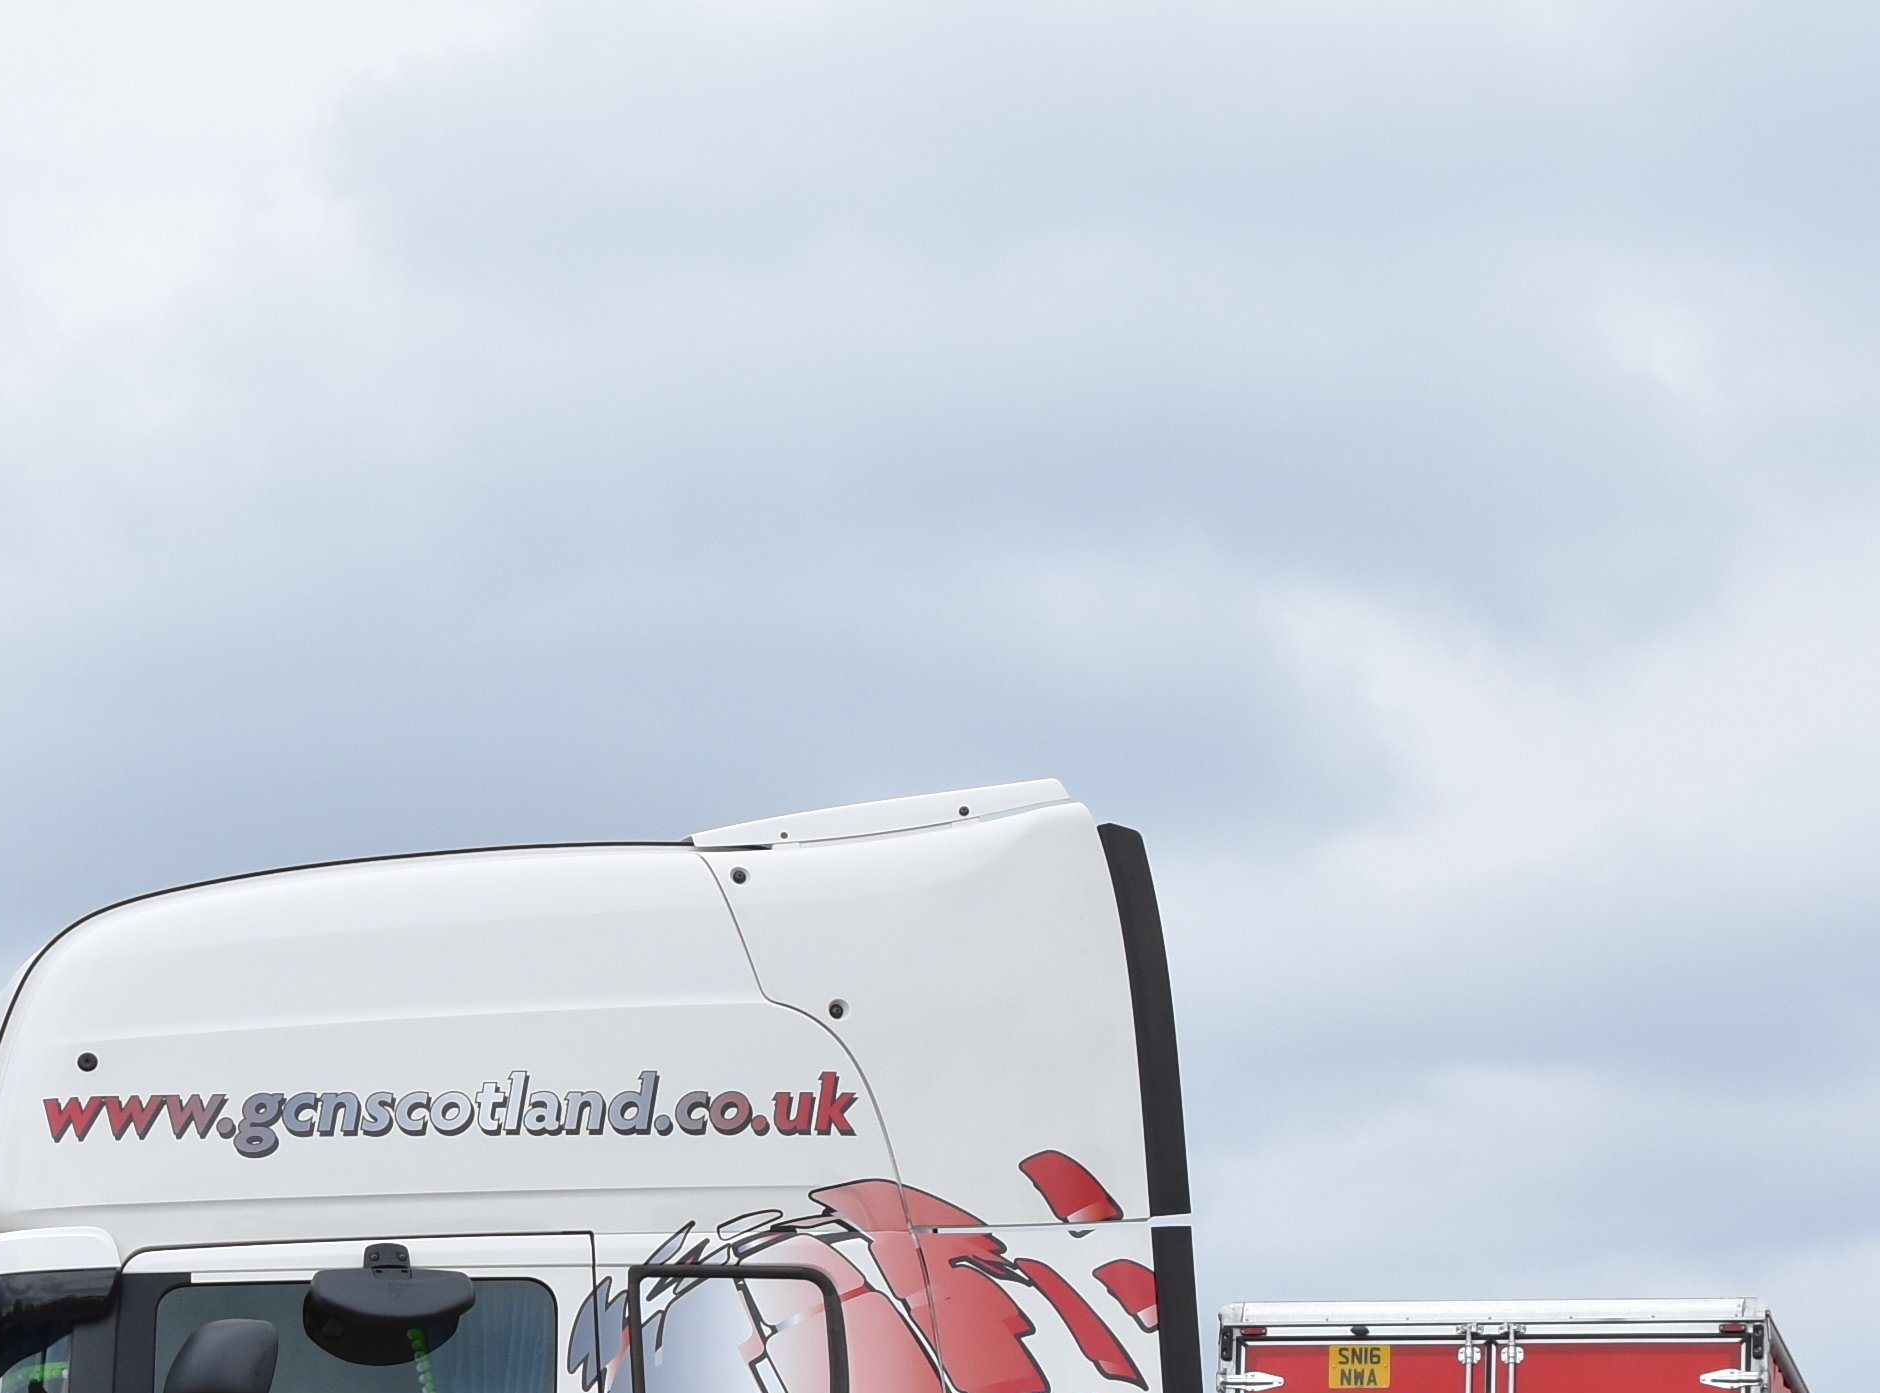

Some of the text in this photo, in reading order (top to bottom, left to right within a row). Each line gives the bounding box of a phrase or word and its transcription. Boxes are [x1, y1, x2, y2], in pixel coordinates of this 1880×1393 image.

[43, 1070, 859, 1158] www.gcnscotland.co.uk
[1338, 1347, 1381, 1365] SN16
[1340, 1368, 1377, 1386] NWA
